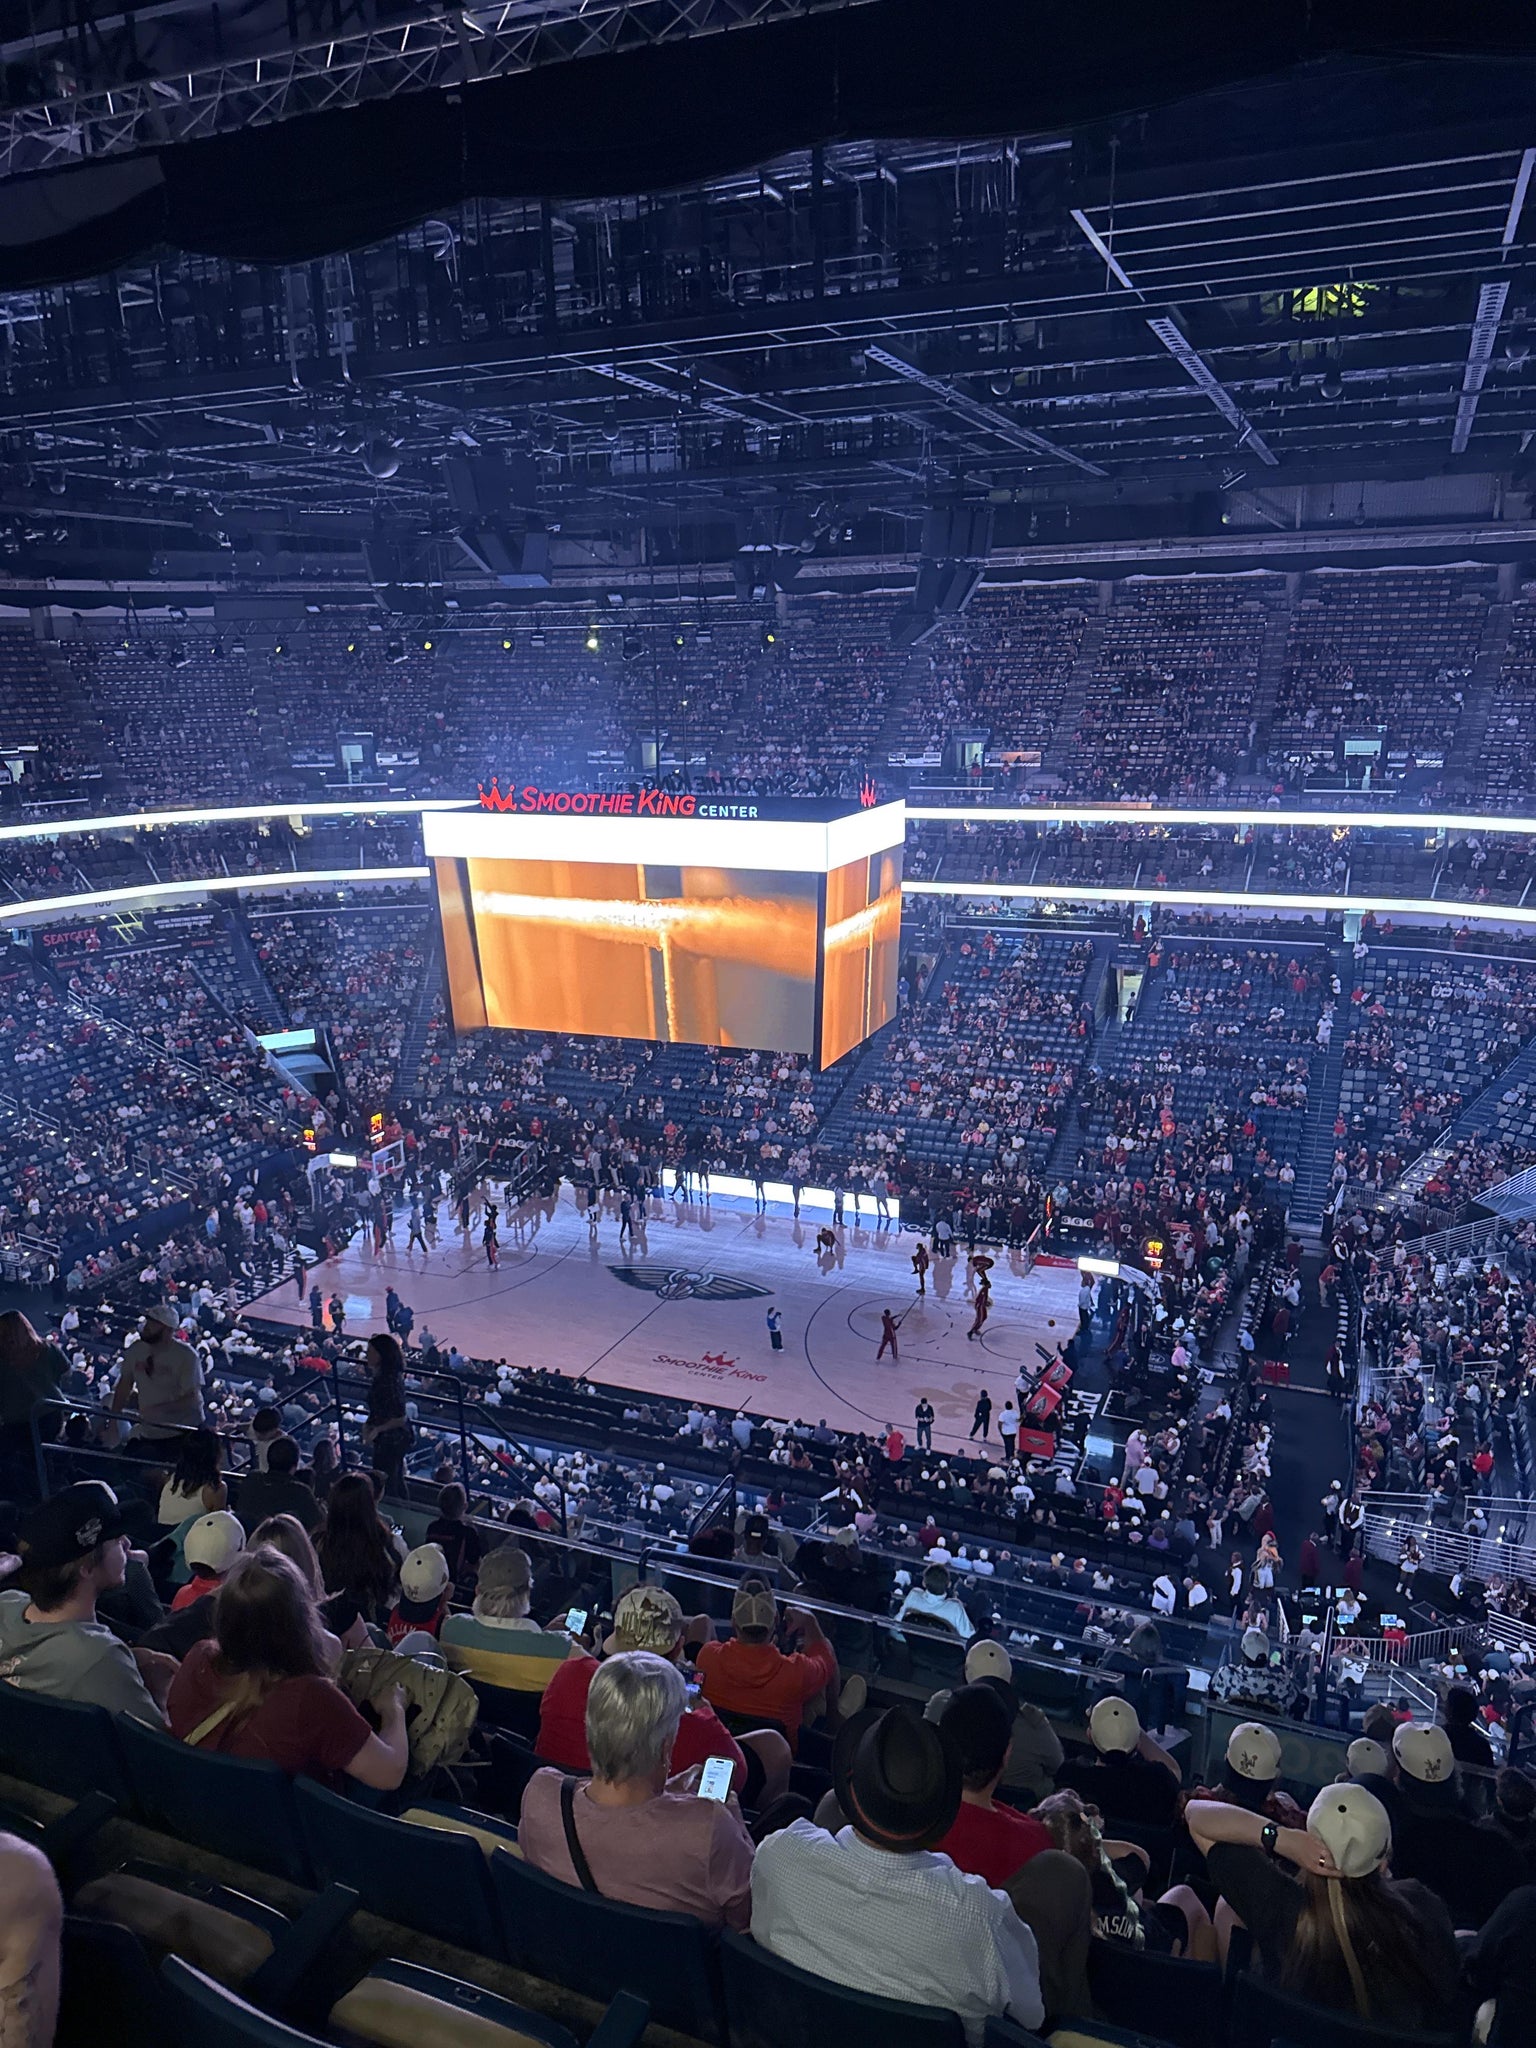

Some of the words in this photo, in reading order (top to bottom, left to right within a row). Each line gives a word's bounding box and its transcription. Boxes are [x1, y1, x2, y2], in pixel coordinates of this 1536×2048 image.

[520, 786, 635, 814] SMOOTHIE
[699, 804, 758, 818] CENTER
[43, 927, 98, 947] SEATGEEK
[652, 1354, 728, 1375] SMOOTHIE
[688, 1370, 724, 1381] CENTER
